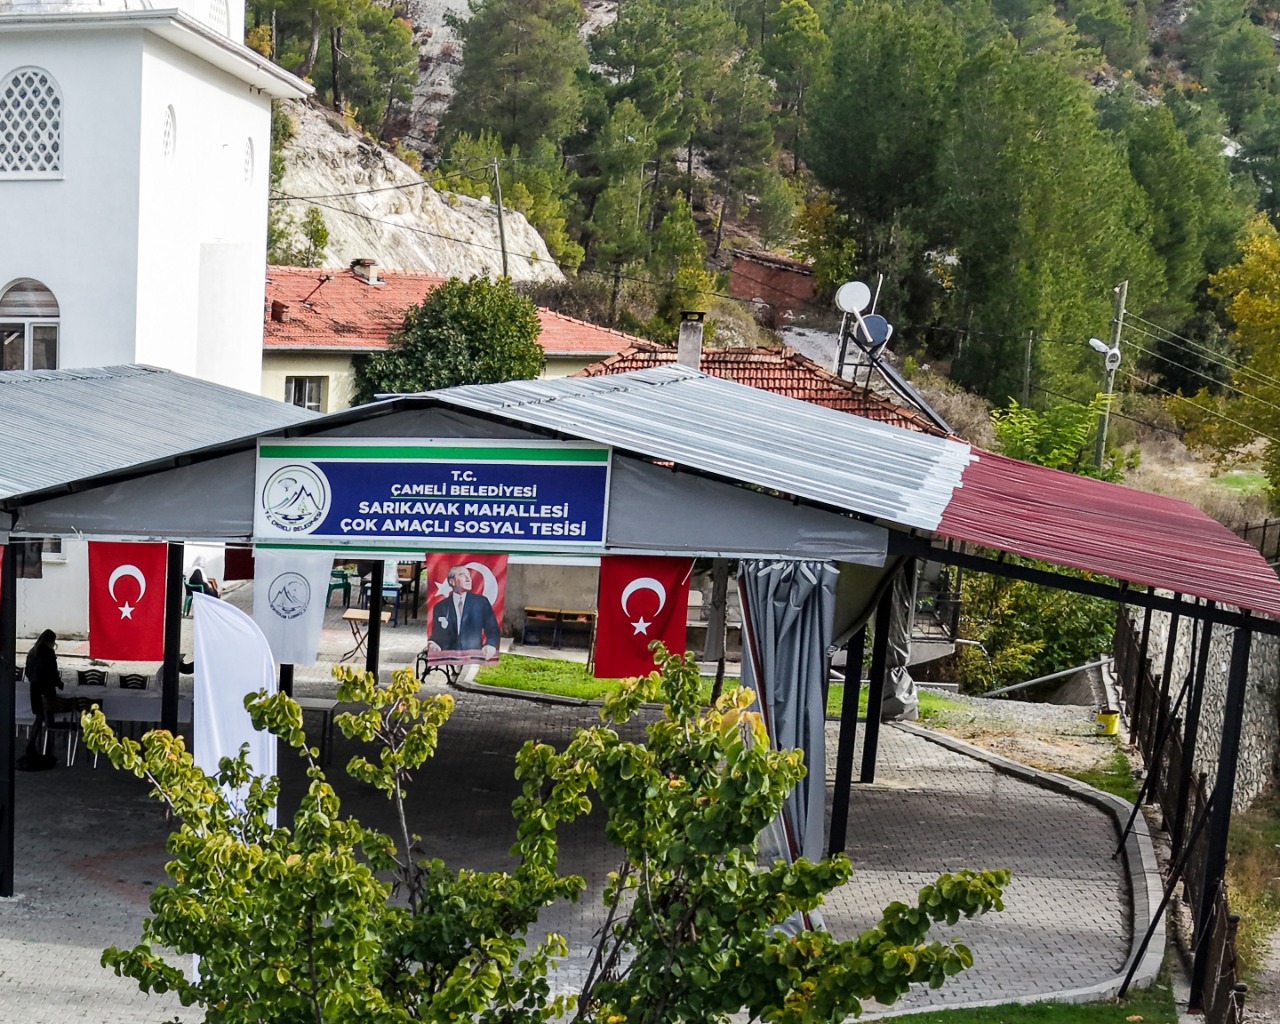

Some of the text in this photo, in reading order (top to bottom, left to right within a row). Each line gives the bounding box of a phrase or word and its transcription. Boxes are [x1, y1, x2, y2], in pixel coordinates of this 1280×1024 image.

[451, 469, 477, 482] T.C.
[391, 482, 537, 498] ÇAMELİ BELEDİYESİ
[359, 501, 569, 518] SARIKAVAK MAHALLESİ
[340, 518, 587, 536] ÇOK AMAÇLI SOSYAL TESİSİ
